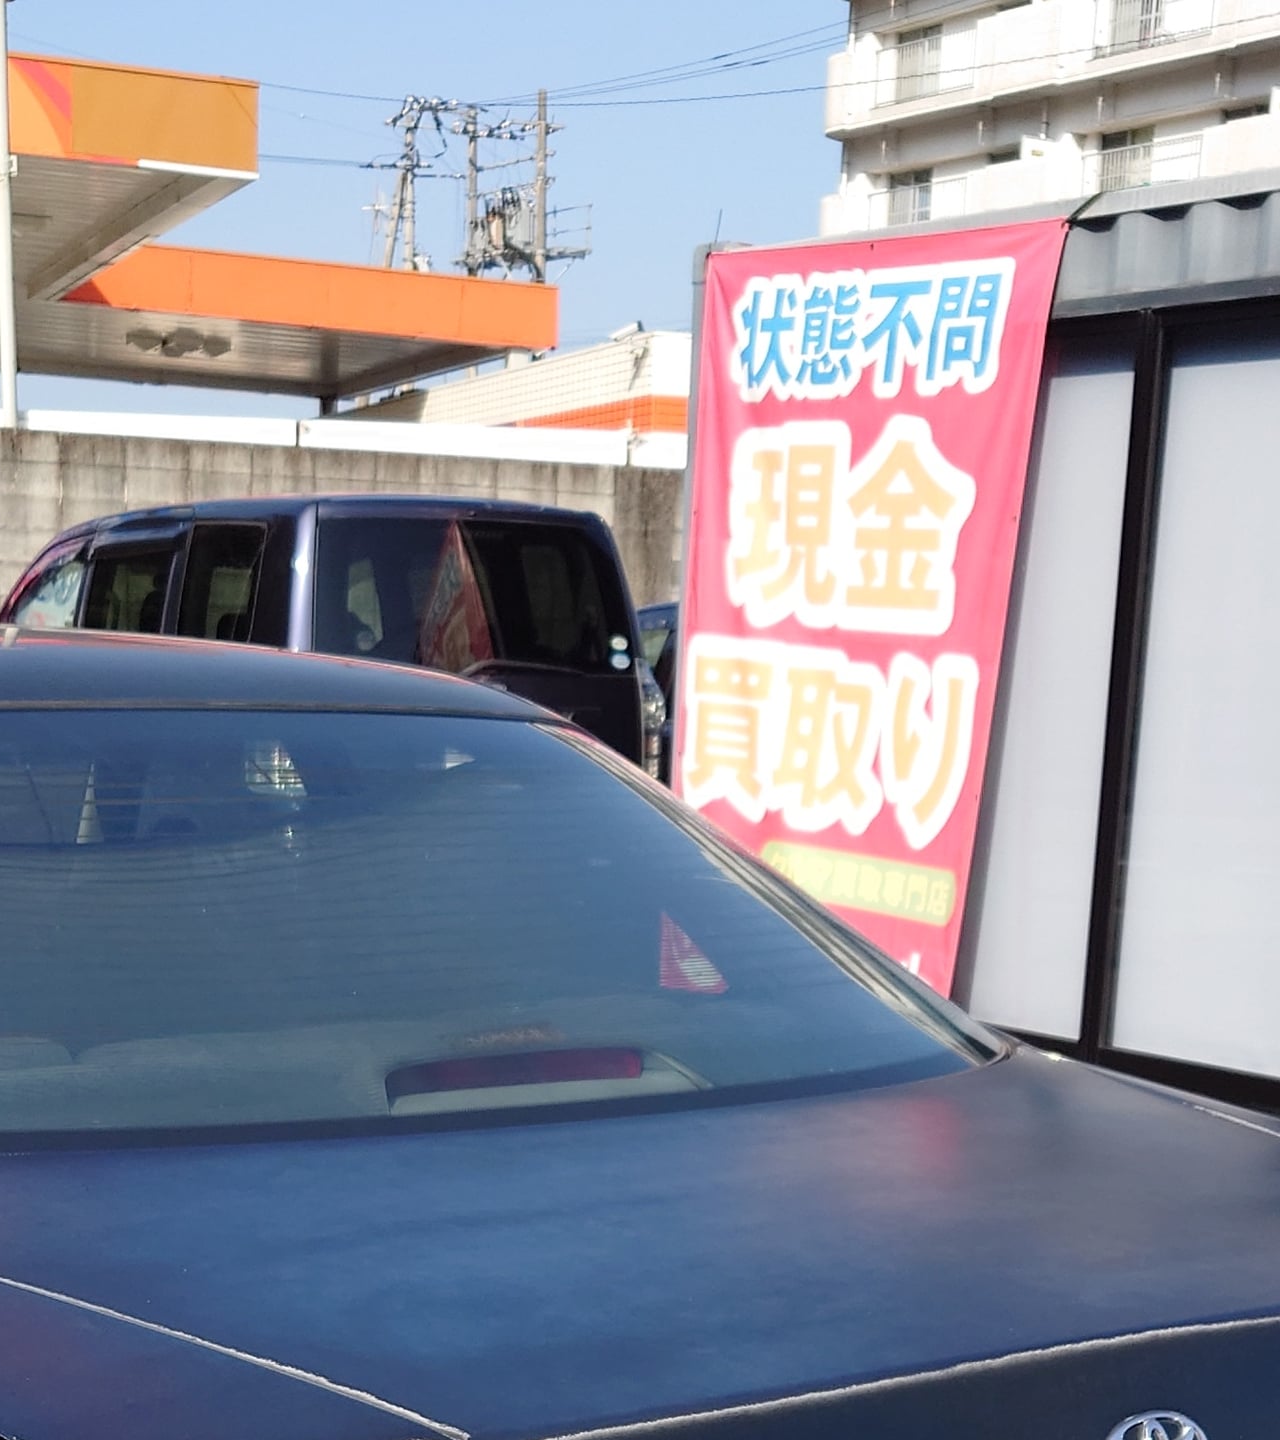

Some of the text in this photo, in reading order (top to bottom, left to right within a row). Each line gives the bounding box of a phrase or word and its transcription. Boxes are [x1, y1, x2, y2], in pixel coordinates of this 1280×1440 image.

[737, 268, 1006, 392] 状態不問
[730, 436, 958, 612] 現金
[687, 654, 964, 828] 買取り
